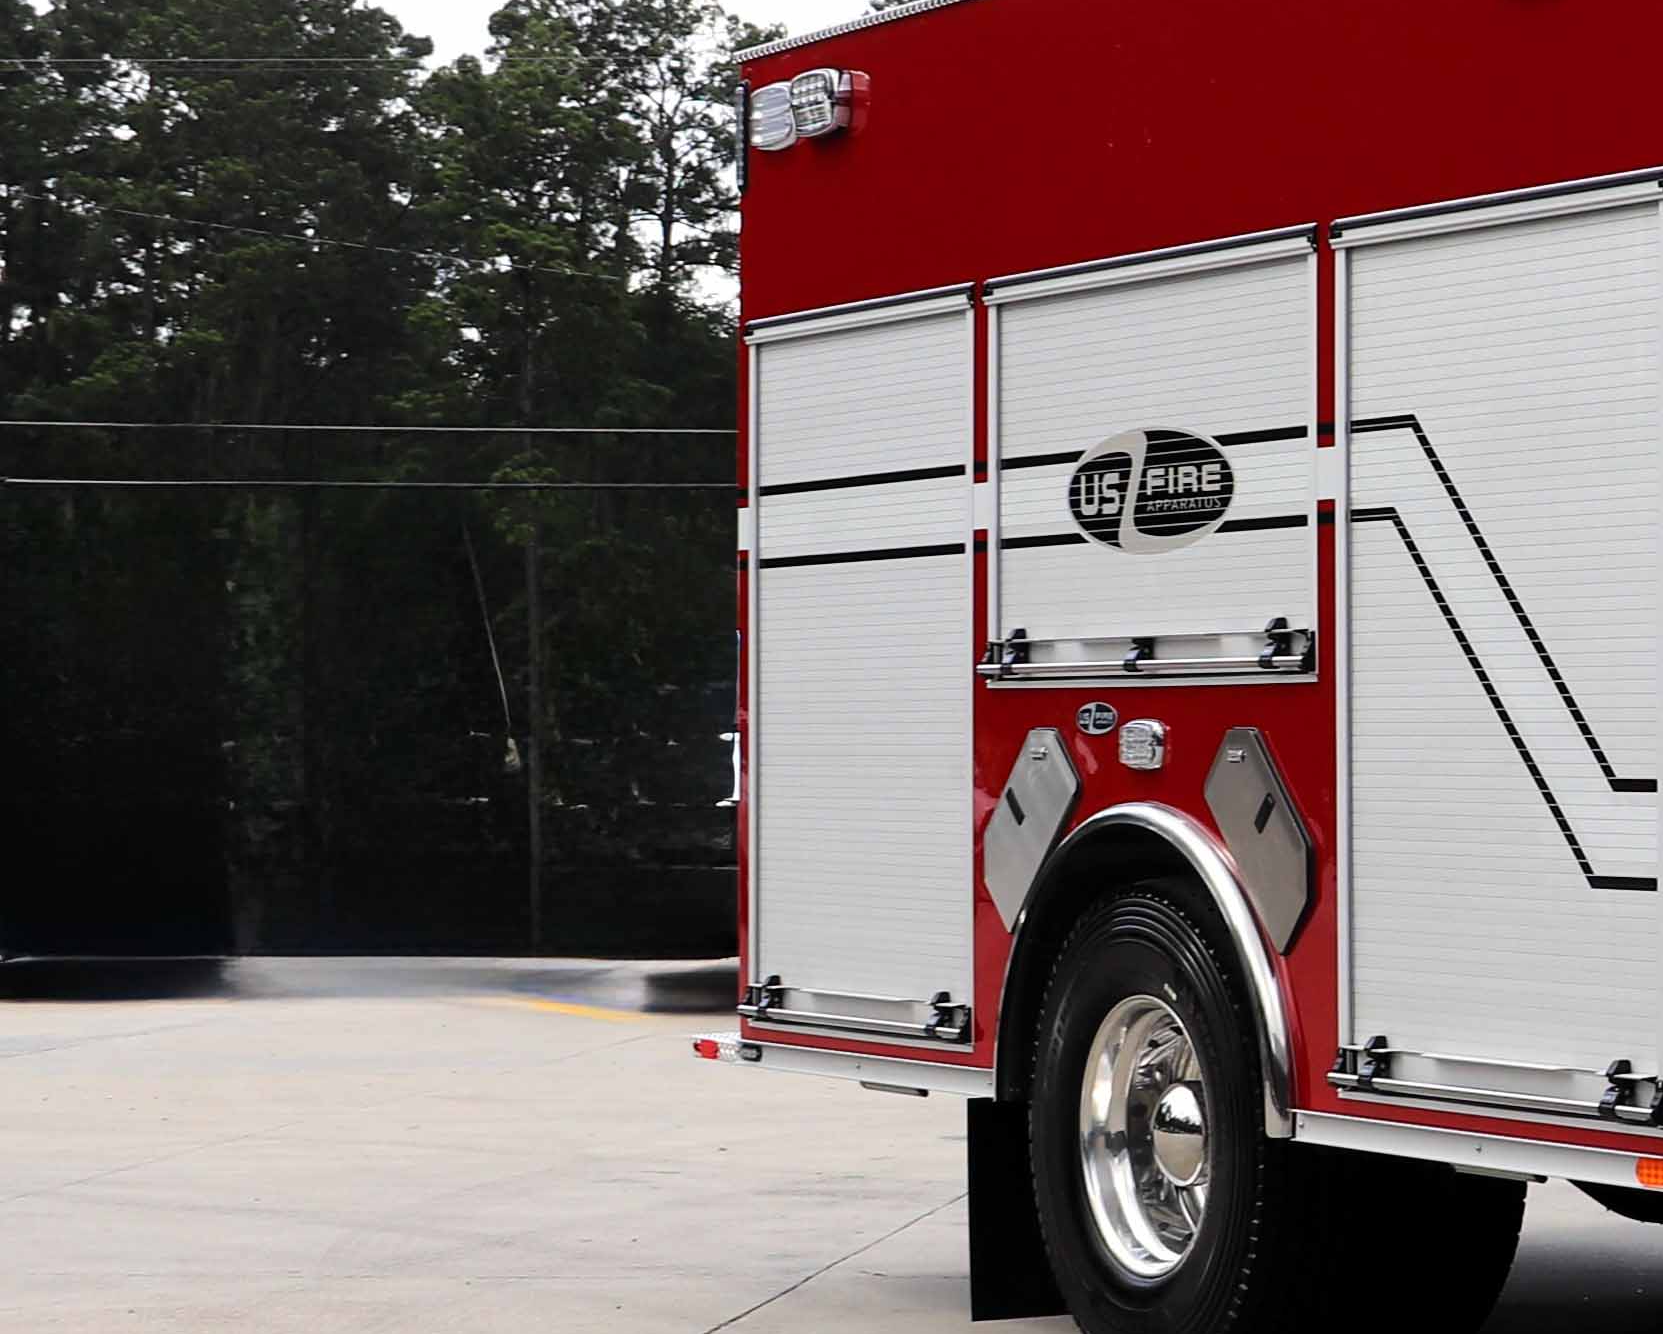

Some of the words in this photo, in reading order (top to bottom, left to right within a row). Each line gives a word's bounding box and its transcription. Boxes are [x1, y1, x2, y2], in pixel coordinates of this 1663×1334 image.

[1080, 472, 1120, 516] US
[1146, 463, 1222, 495] FIRE
[1146, 497, 1222, 512] APPARATUS
